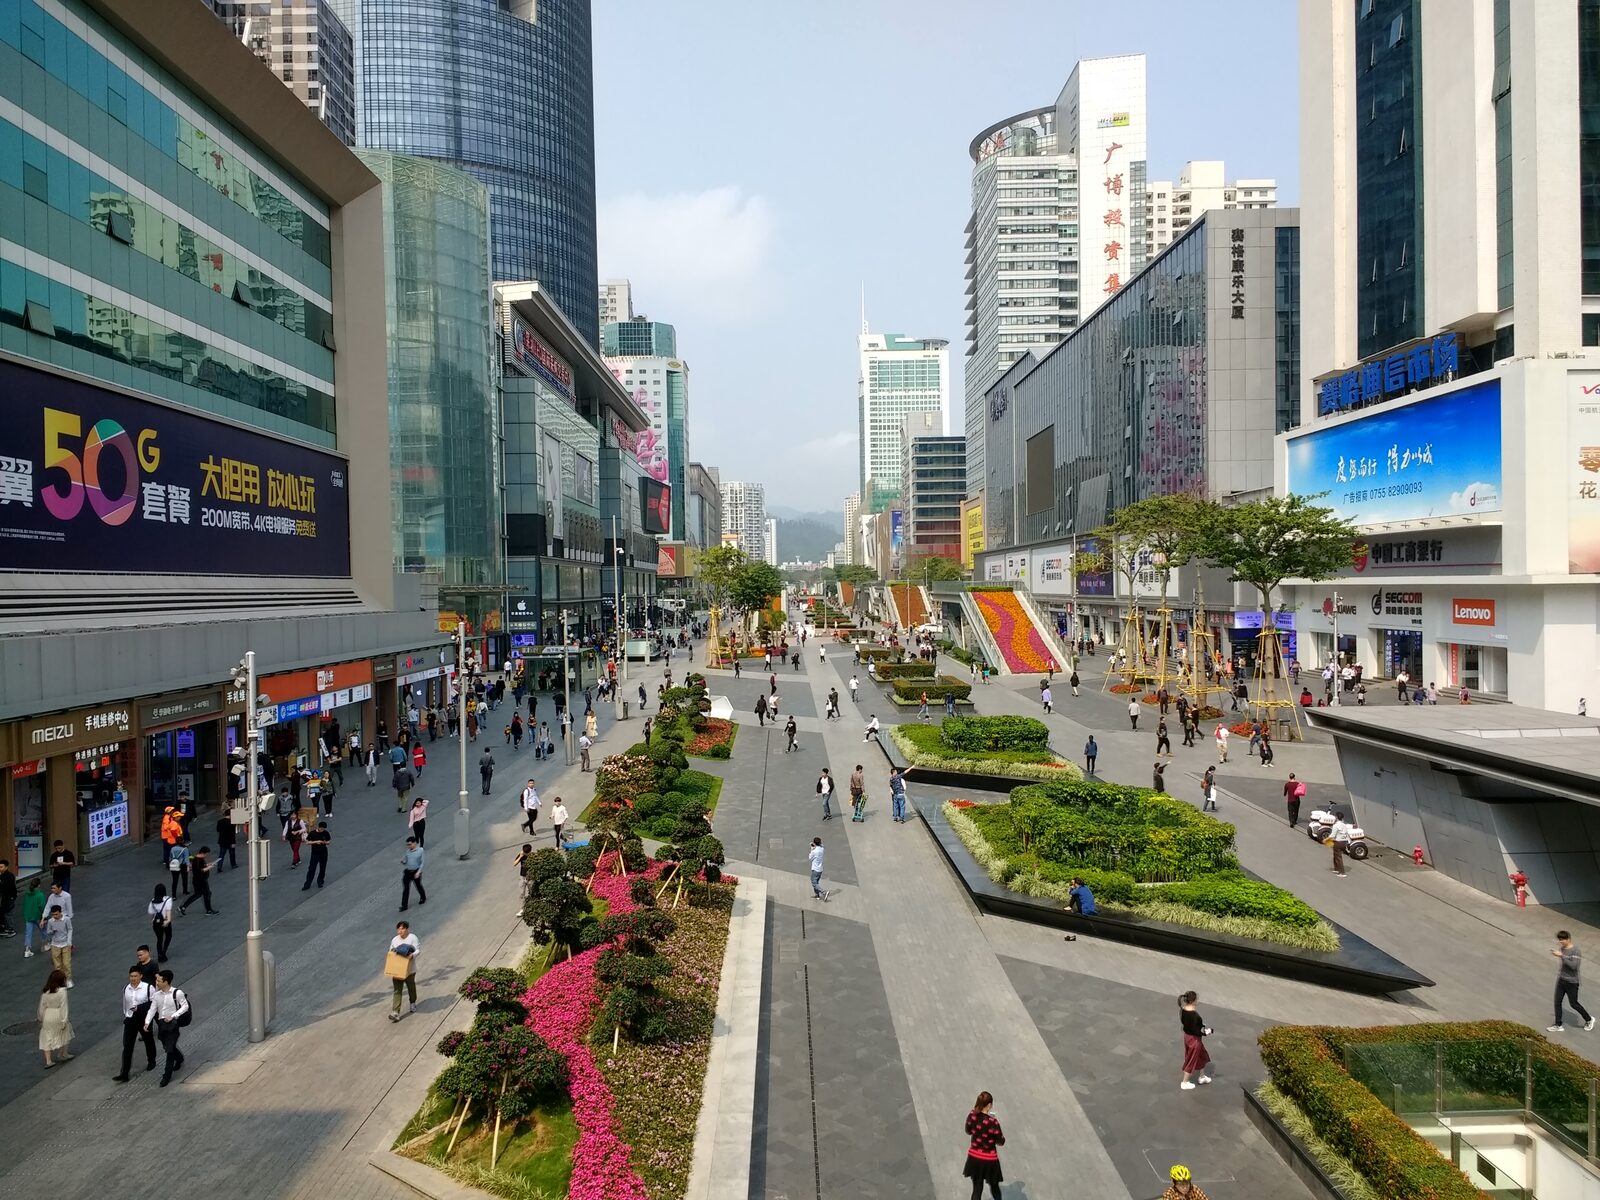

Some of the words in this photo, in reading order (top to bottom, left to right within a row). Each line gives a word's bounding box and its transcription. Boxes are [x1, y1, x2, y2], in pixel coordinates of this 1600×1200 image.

[1231, 228, 1245, 320] 赛格康乐大厦
[200, 455, 260, 505] 大胆用
[267, 468, 316, 514] 放心玩
[1343, 490, 1368, 504] 广告招商
[1369, 487, 1386, 500] 0755
[1388, 481, 1423, 498] 82909093
[1579, 480, 1597, 499] 花
[142, 481, 191, 525] 套餐
[1371, 540, 1443, 564] 中国工商银行
[1385, 592, 1422, 604] SEGCOM
[1455, 604, 1491, 620] Lenovo
[85, 710, 129, 731] 手机维修中心
[31, 723, 74, 744] MEIZU
